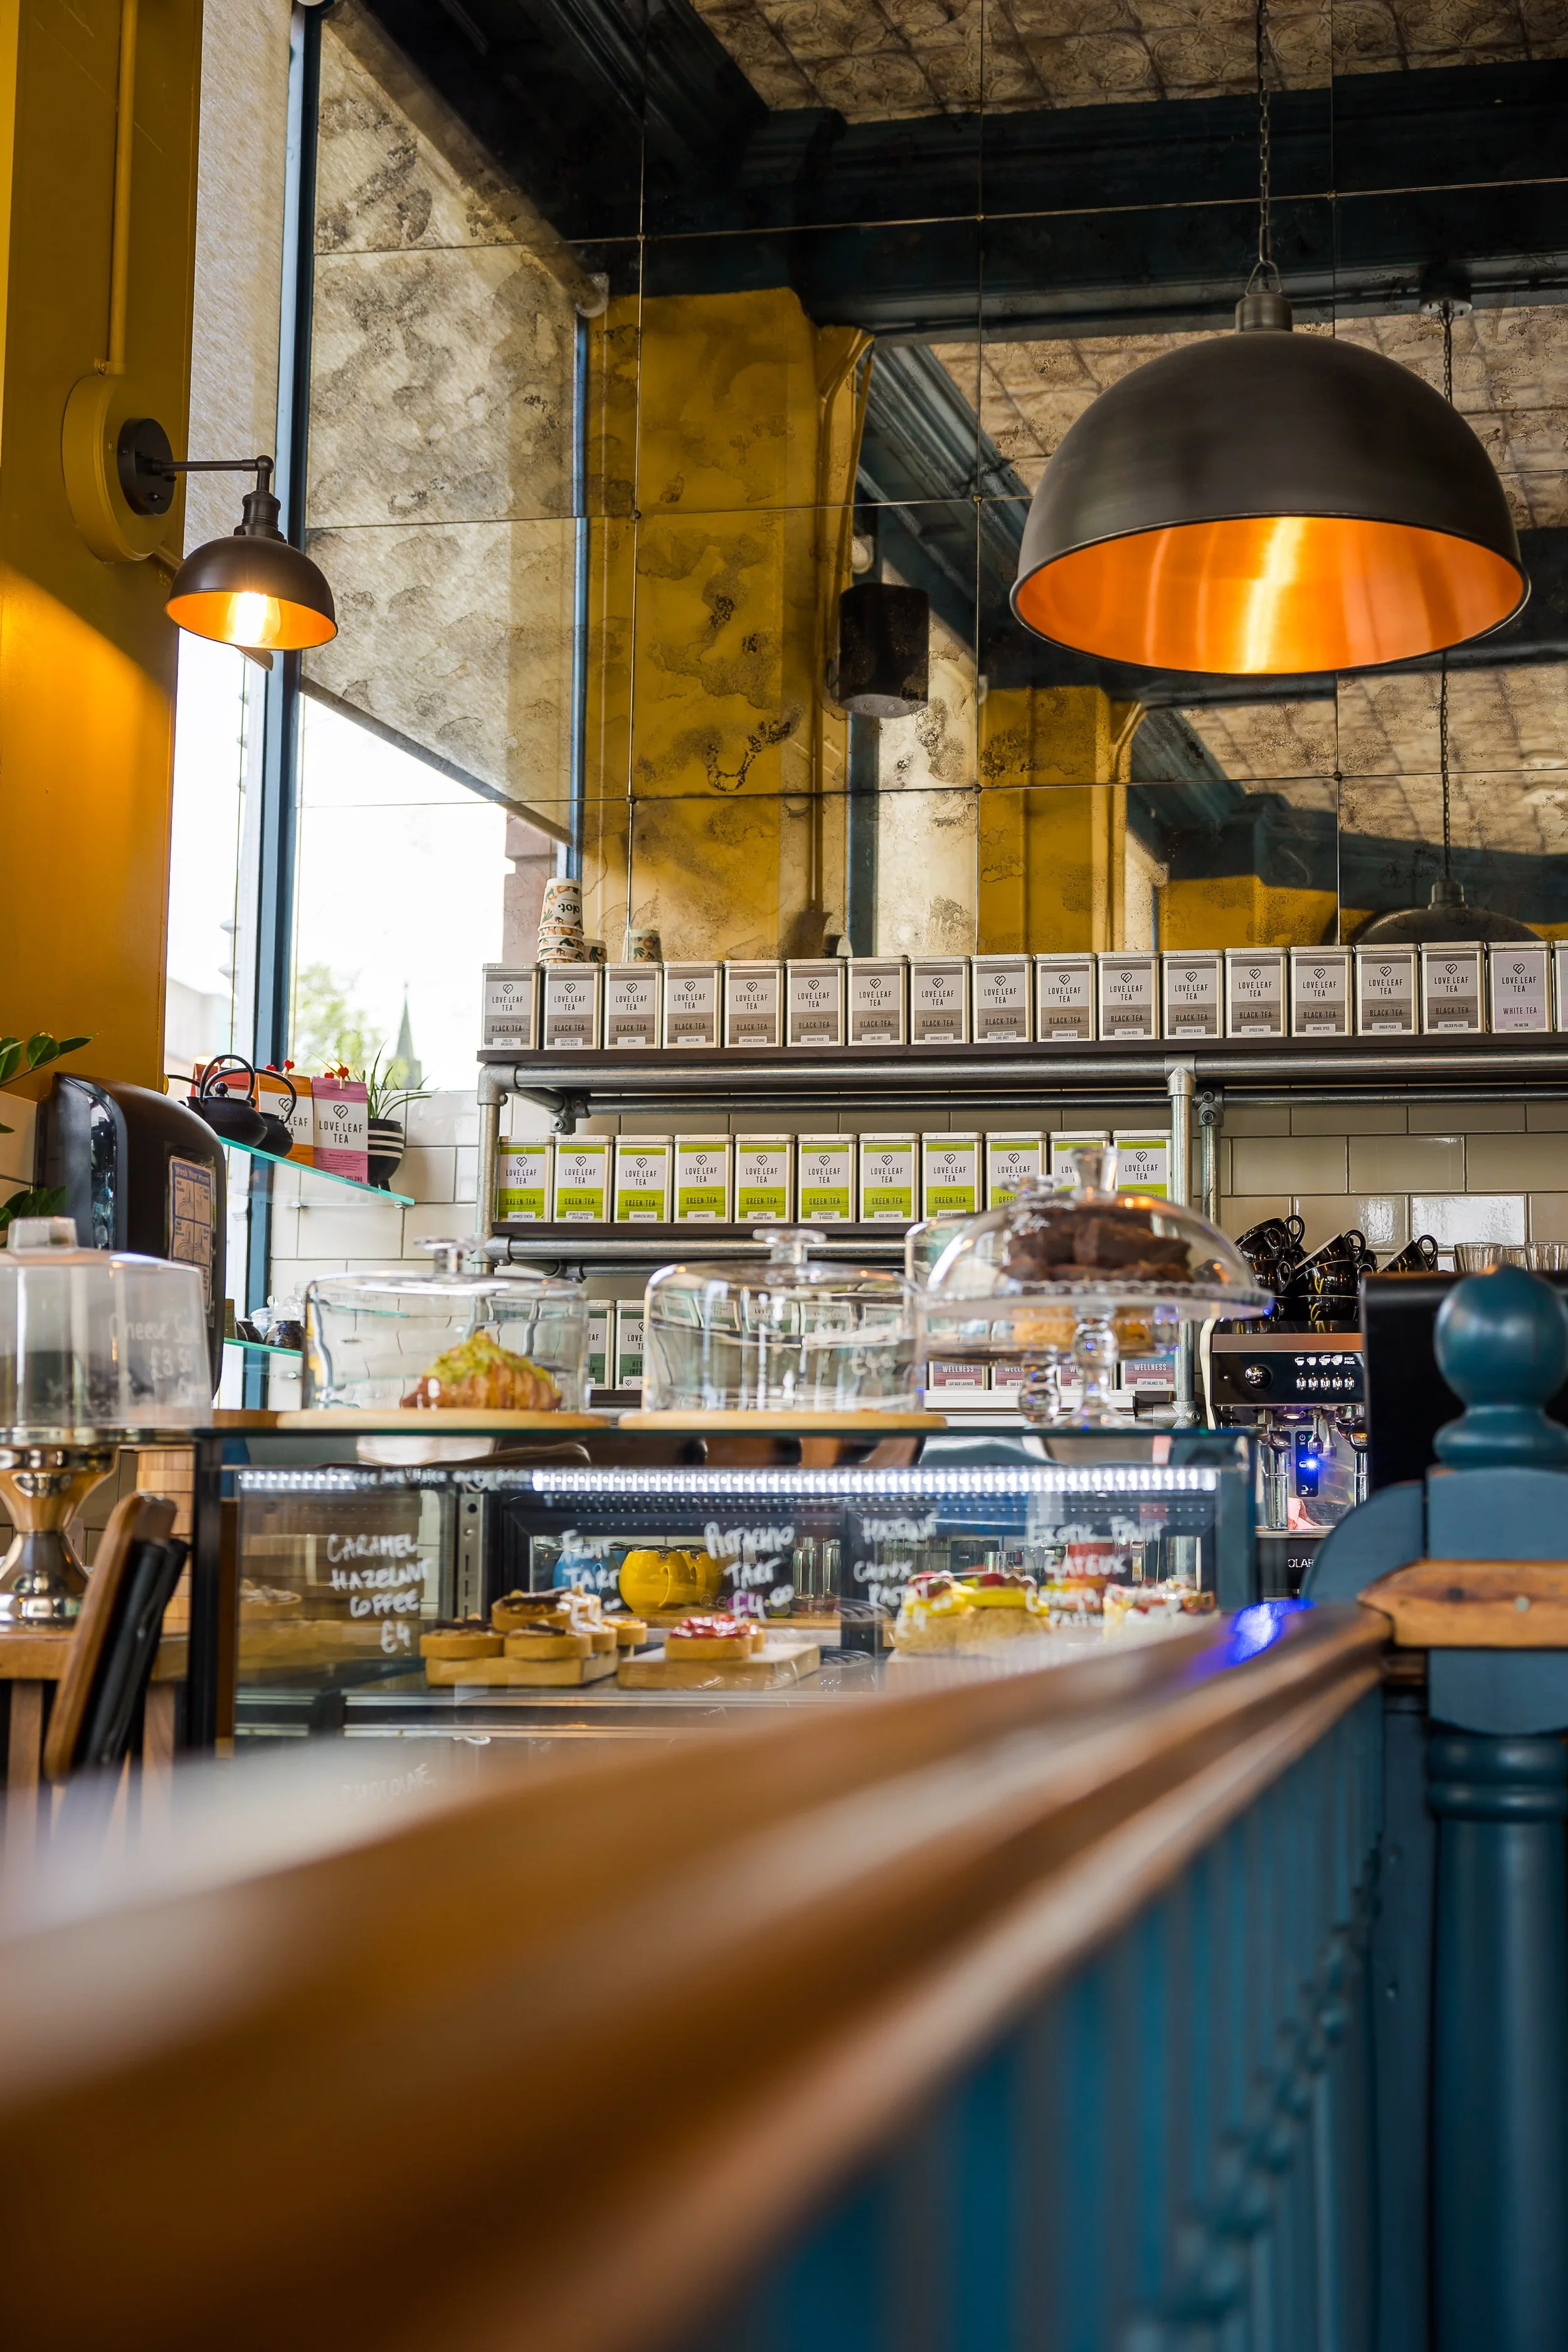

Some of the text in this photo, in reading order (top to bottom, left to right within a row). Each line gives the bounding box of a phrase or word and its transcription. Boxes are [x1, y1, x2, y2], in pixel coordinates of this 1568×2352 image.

[1369, 1009, 1389, 1017] BLACK
[289, 1117, 308, 1127] LEAF
[319, 1121, 363, 1133] LOVE LEAF
[334, 1133, 349, 1144] TEA
[327, 1533, 418, 1562] CARAMEL
[331, 1557, 433, 1591] HAZELNUT
